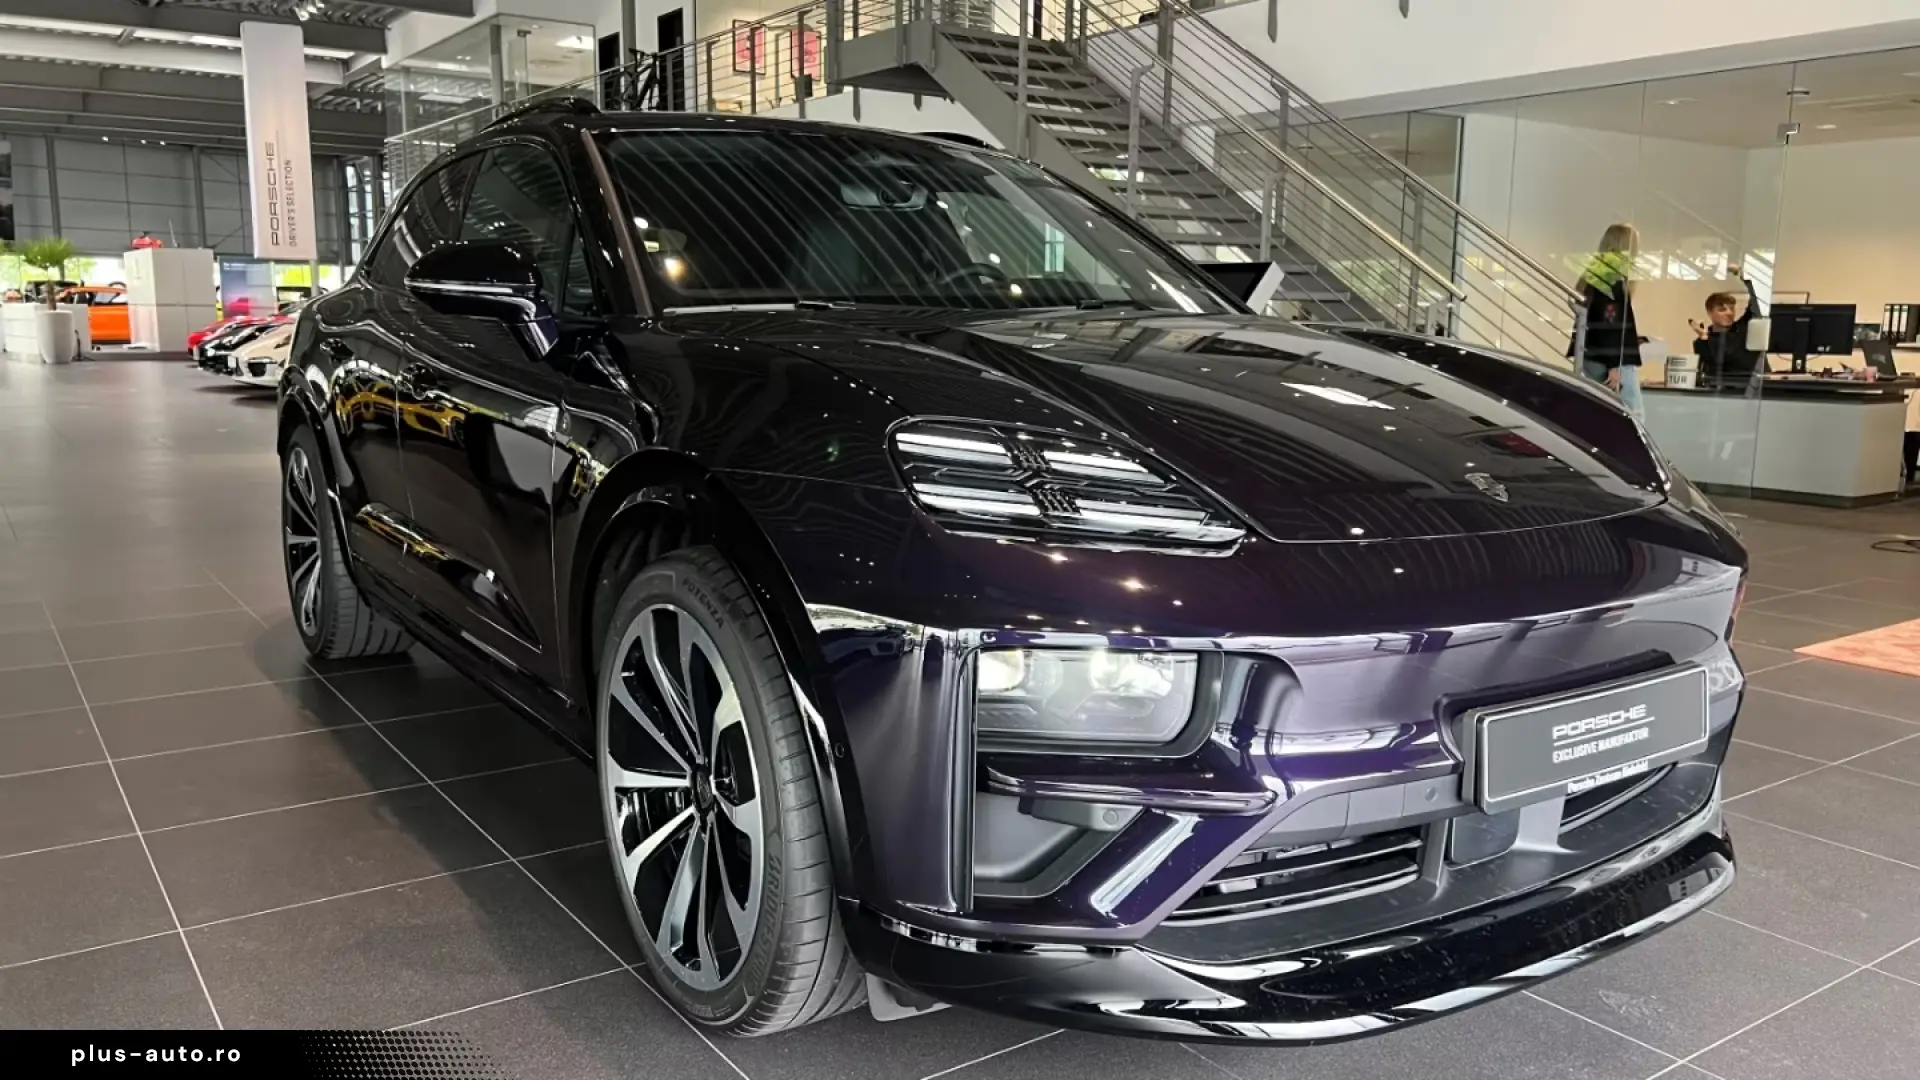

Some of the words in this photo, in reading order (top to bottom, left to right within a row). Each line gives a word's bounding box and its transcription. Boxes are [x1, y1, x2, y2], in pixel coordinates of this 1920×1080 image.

[265, 142, 280, 246] PORSCHE
[284, 159, 295, 207] SELECTION
[1552, 703, 1647, 739] PORSCHE
[1552, 741, 1598, 764] EXCLUSIVE
[1598, 727, 1649, 752] MANUFAKTUR
